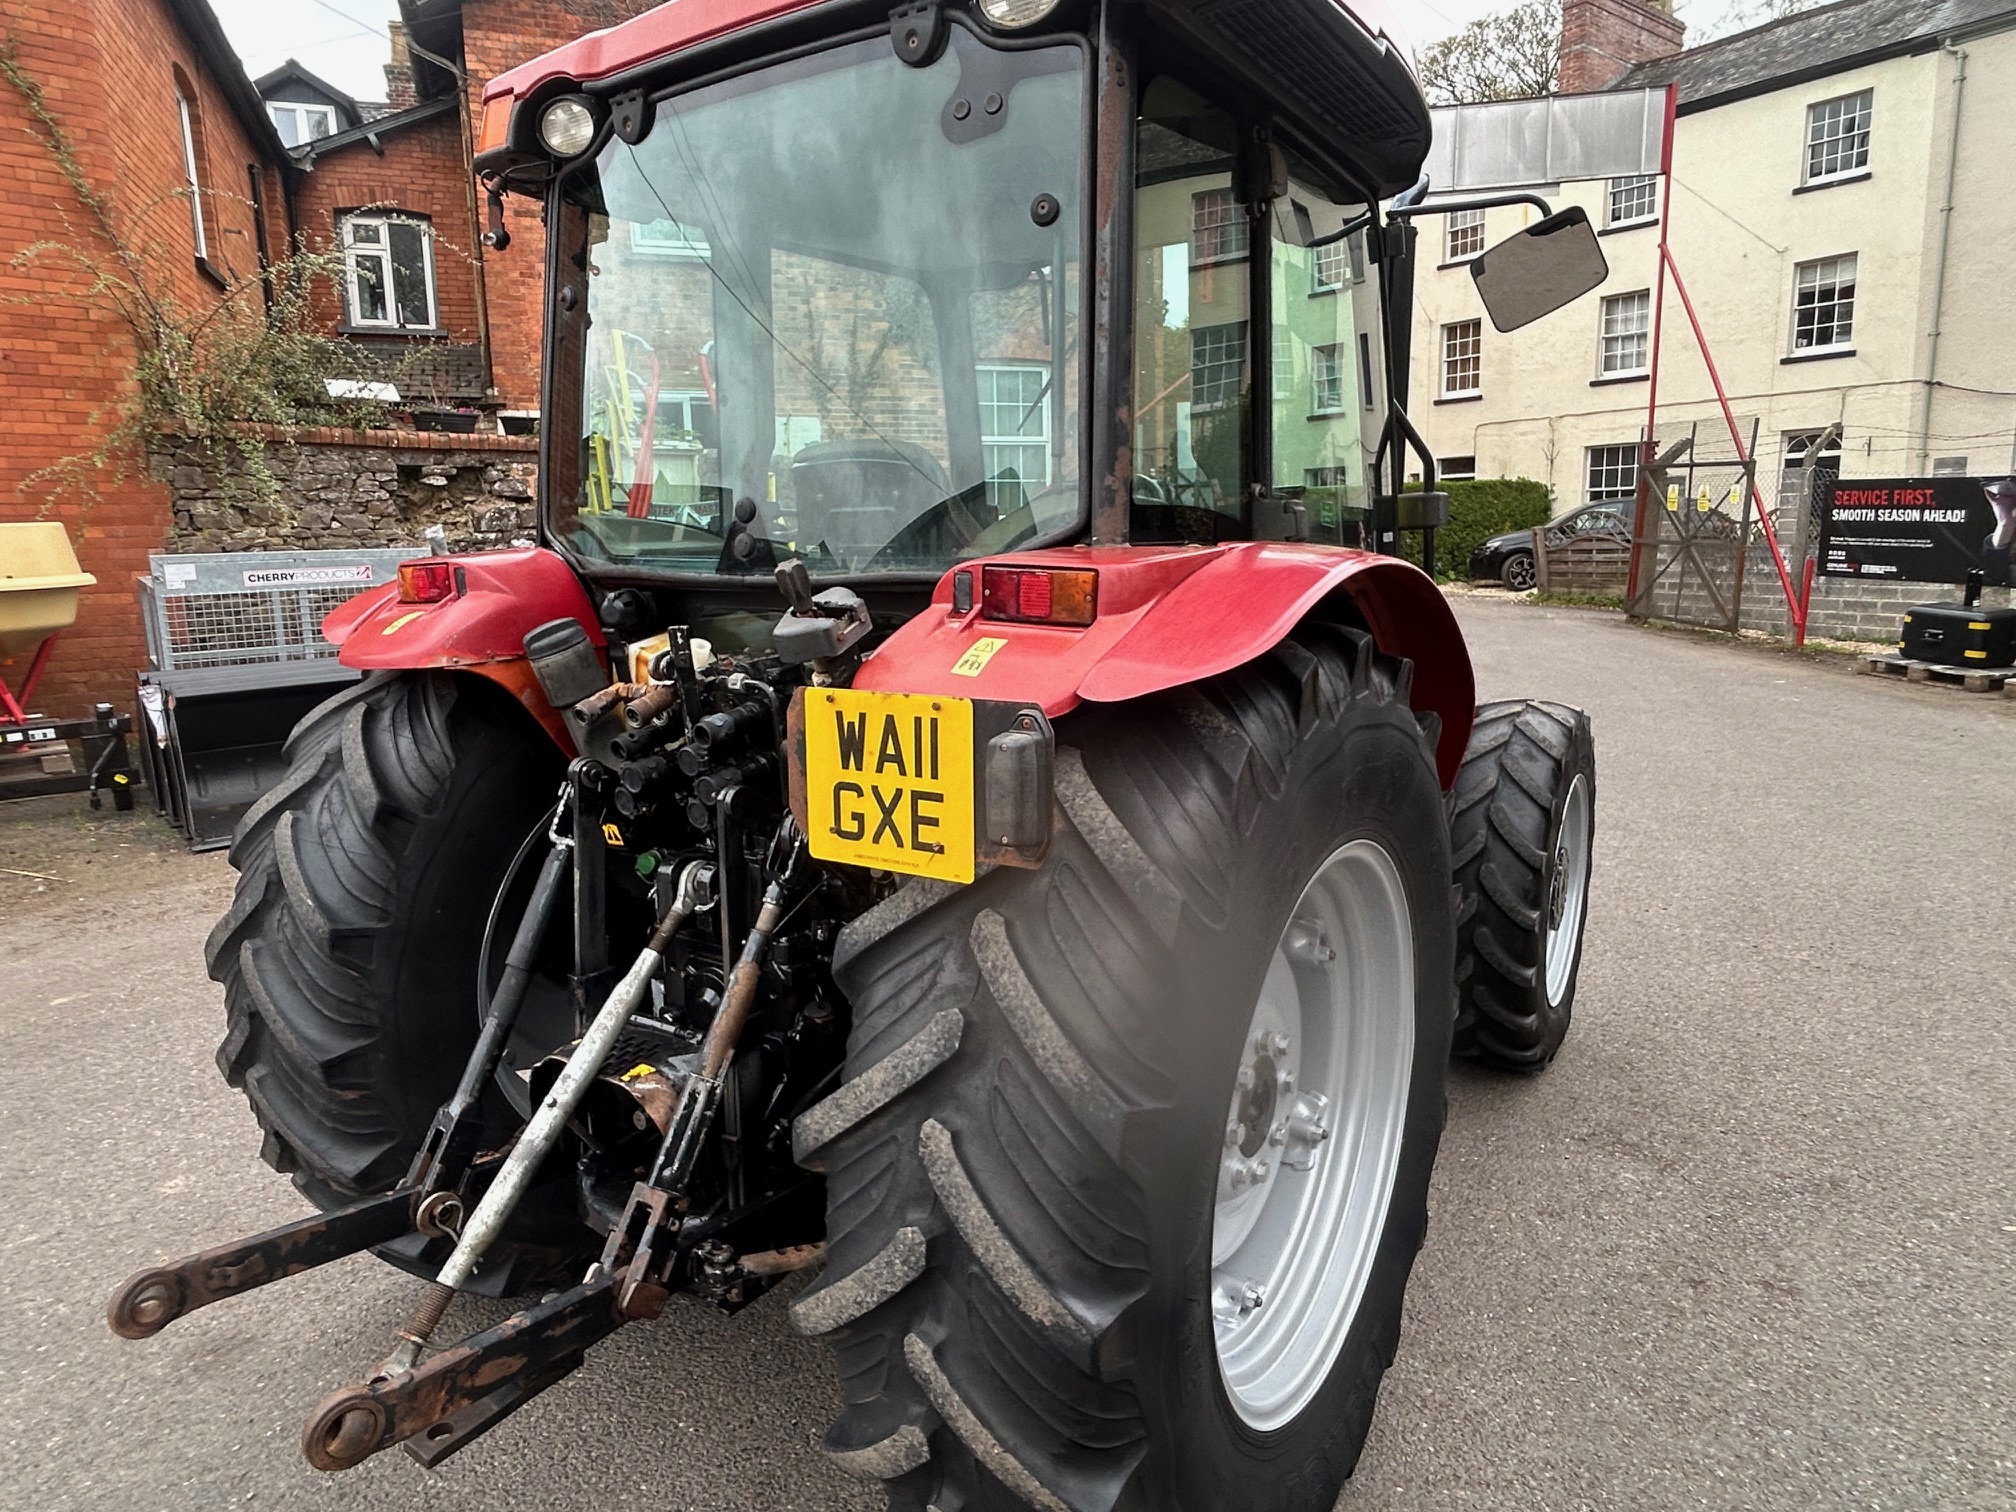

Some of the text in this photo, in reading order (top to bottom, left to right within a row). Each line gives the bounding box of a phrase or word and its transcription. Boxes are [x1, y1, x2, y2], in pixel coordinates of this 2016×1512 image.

[1832, 508, 1966, 522] SMOOTH SEASON AHEAD!
[1834, 490, 1889, 505] SERVICE
[835, 709, 939, 780] WA11
[832, 781, 945, 855] GXE
